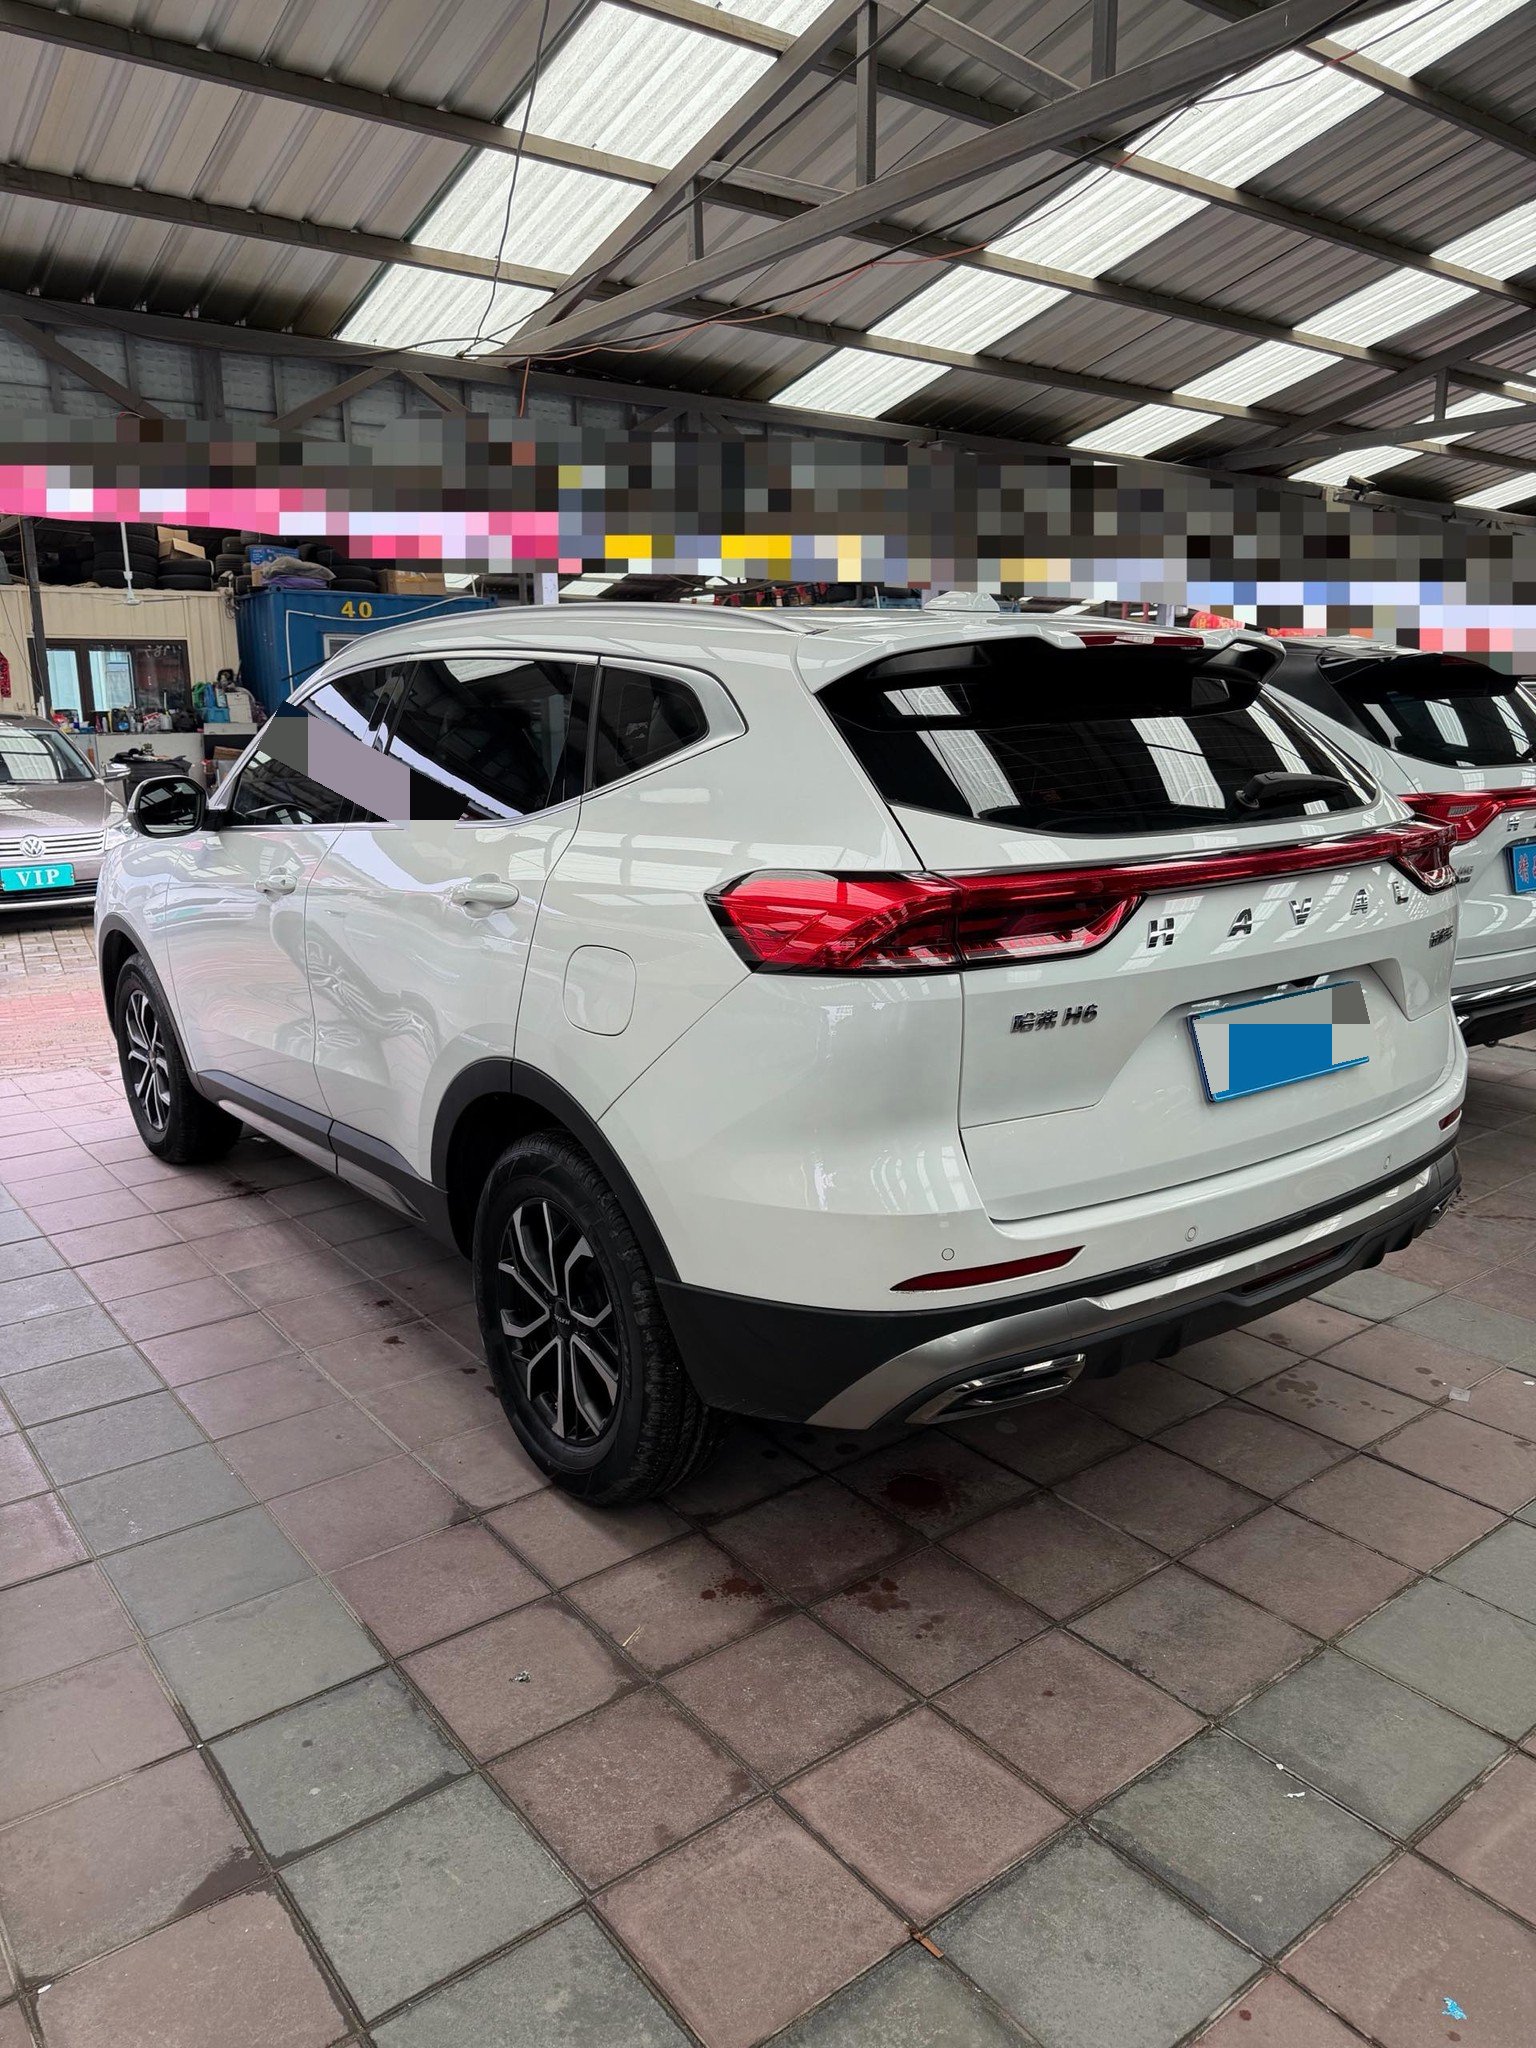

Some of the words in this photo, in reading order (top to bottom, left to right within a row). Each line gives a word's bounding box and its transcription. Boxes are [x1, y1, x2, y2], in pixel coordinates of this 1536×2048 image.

[341, 600, 373, 619] 40
[16, 868, 60, 888] VIP
[1147, 881, 1409, 948] HAVAL
[1010, 1009, 1059, 1034] 哈弗
[1061, 1003, 1098, 1027] H6
